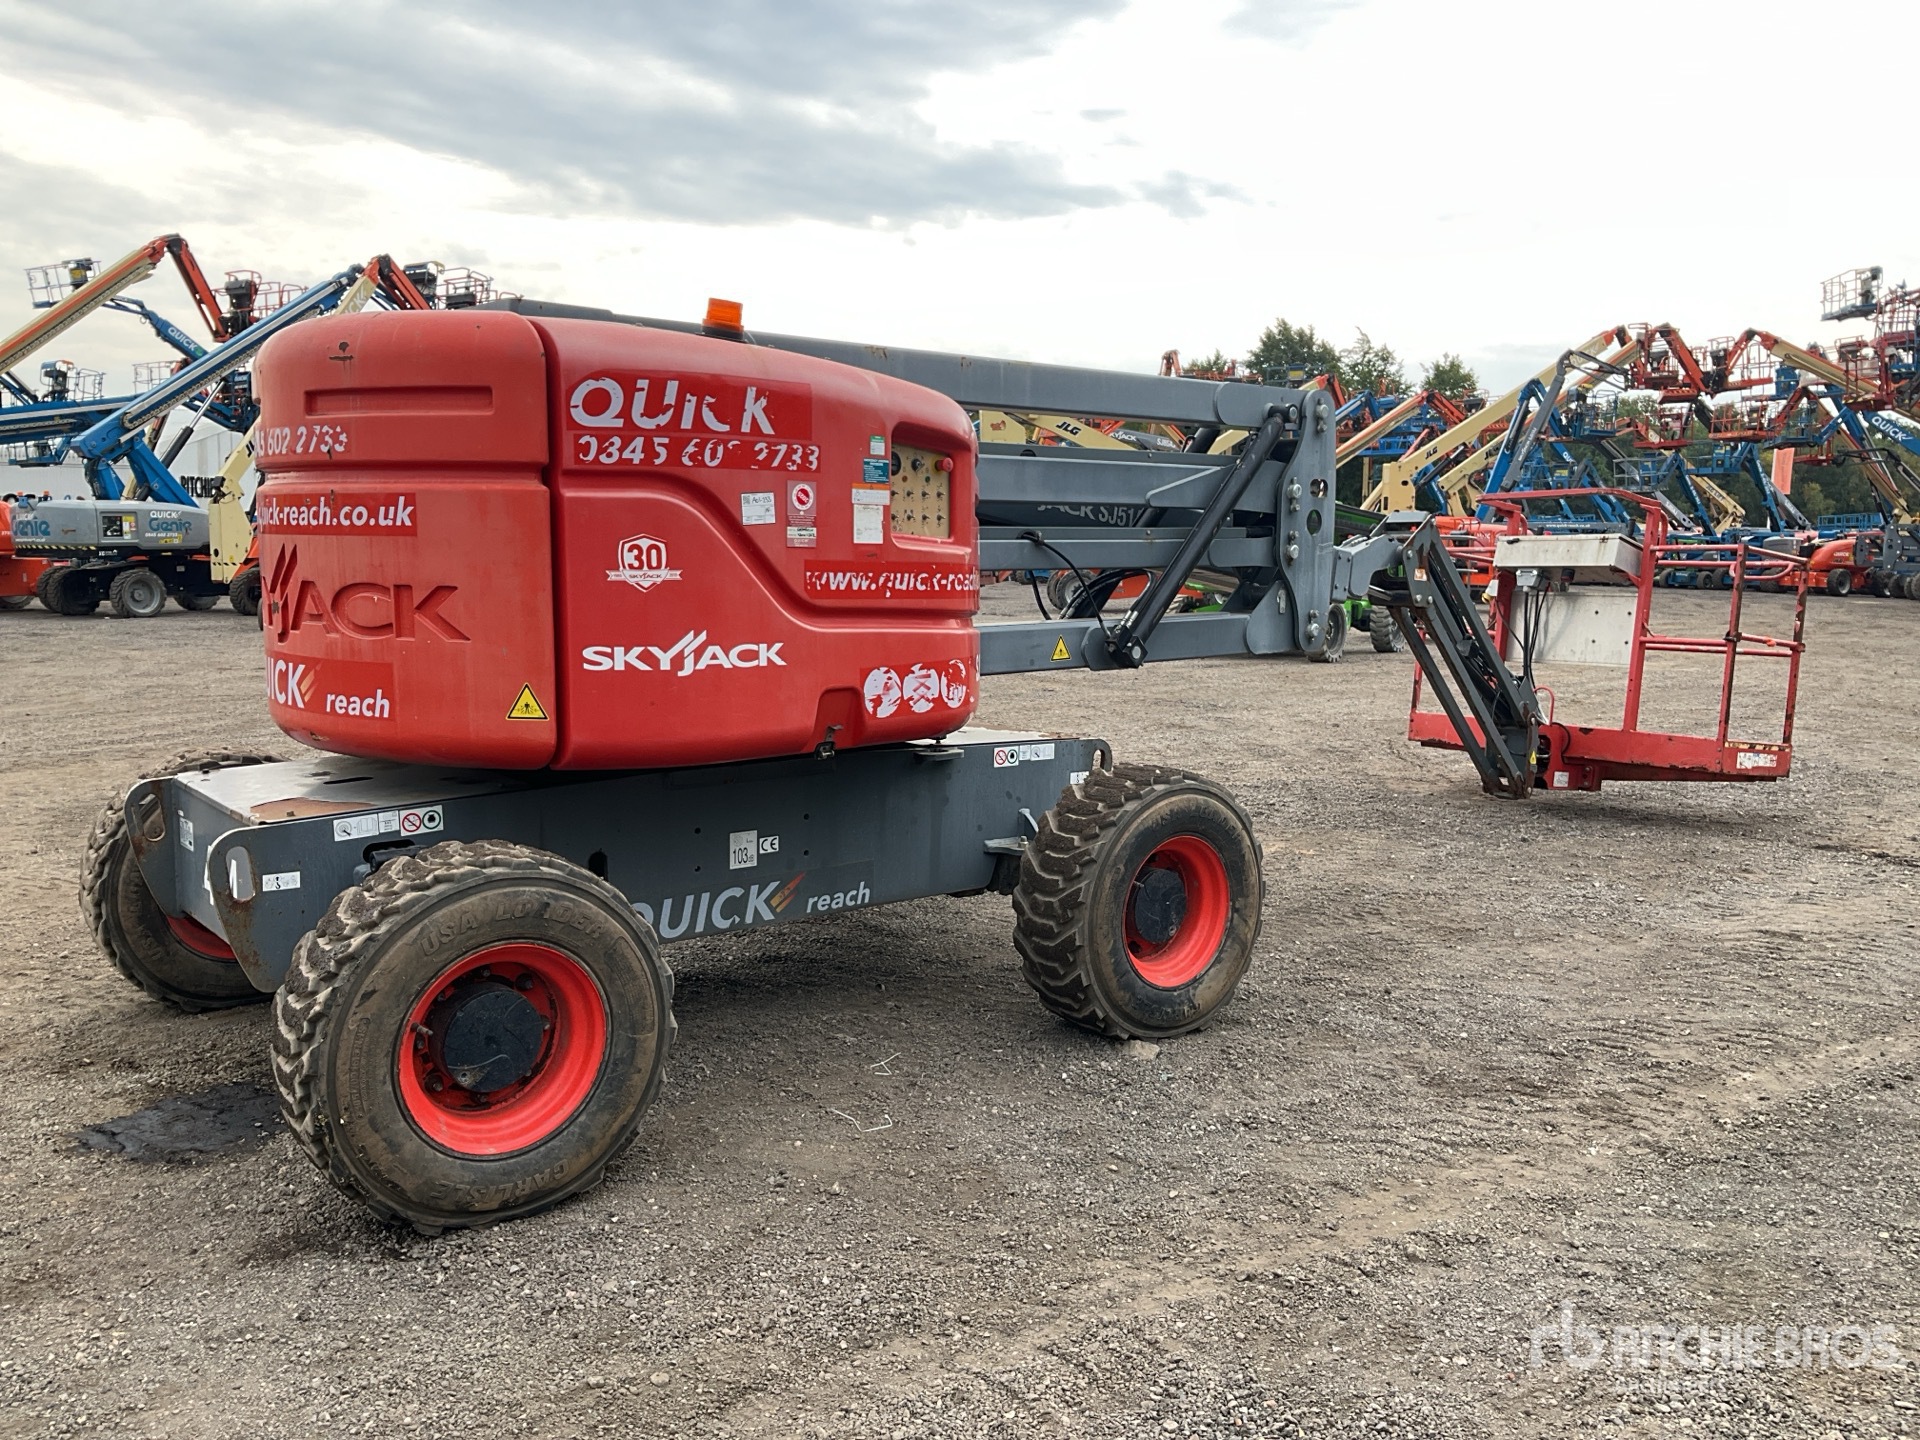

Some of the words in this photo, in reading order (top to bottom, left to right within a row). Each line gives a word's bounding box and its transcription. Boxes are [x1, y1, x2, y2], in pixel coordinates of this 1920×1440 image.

[167, 326, 198, 351] QUICK
[570, 377, 775, 435] QUICK
[268, 427, 290, 456] 602
[295, 424, 348, 454] 2733
[1056, 422, 1081, 435] JLG
[1871, 416, 1906, 441] QUICK
[1425, 446, 1438, 460] JLG
[148, 517, 192, 532] Genie
[627, 543, 662, 570] 30
[629, 571, 662, 580] SKYJACK
[582, 629, 788, 677] SKYJACK
[326, 688, 390, 718] reach
[732, 846, 748, 864] 103
[806, 880, 871, 914] reach
[420, 911, 479, 957] USA
[430, 1158, 570, 1203] CARLISLE
